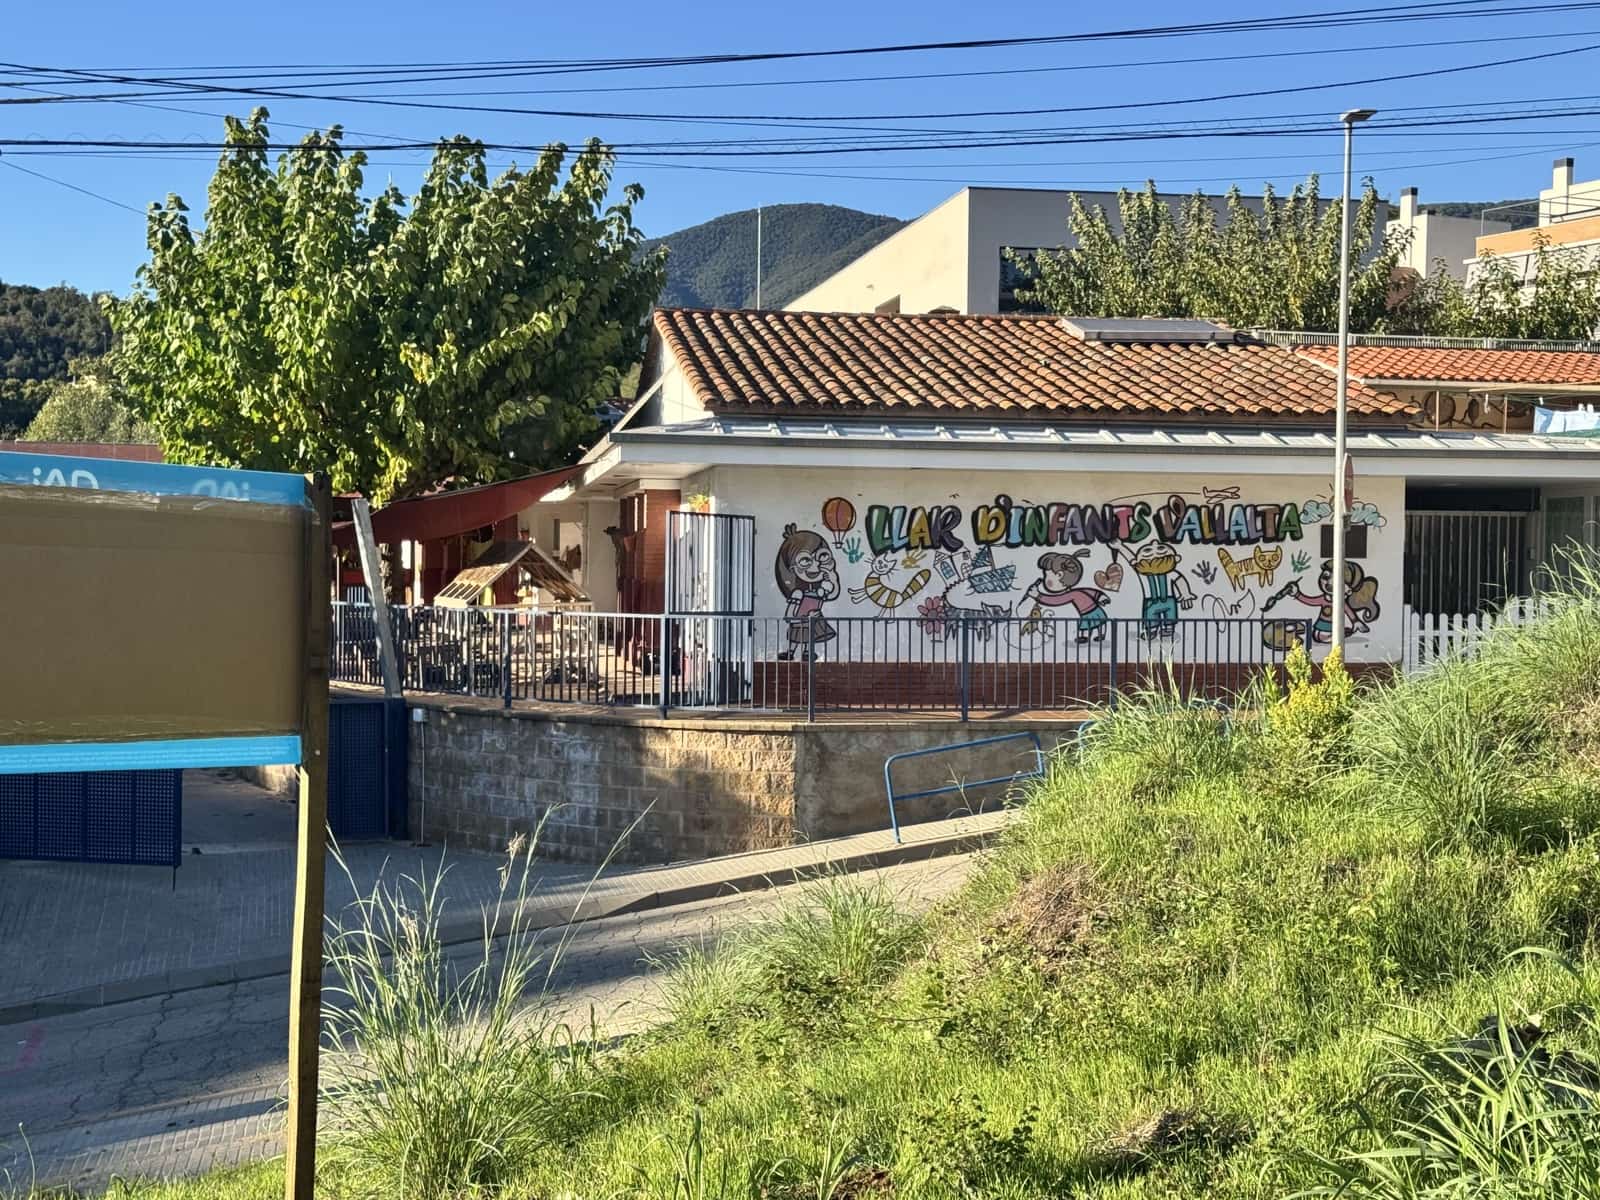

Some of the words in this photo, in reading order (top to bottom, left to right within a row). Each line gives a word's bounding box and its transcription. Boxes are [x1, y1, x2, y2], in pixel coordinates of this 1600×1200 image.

[865, 504, 964, 557] LLAR
[971, 494, 1152, 548] D'INFANTS
[1152, 495, 1303, 546] VALLALTA
